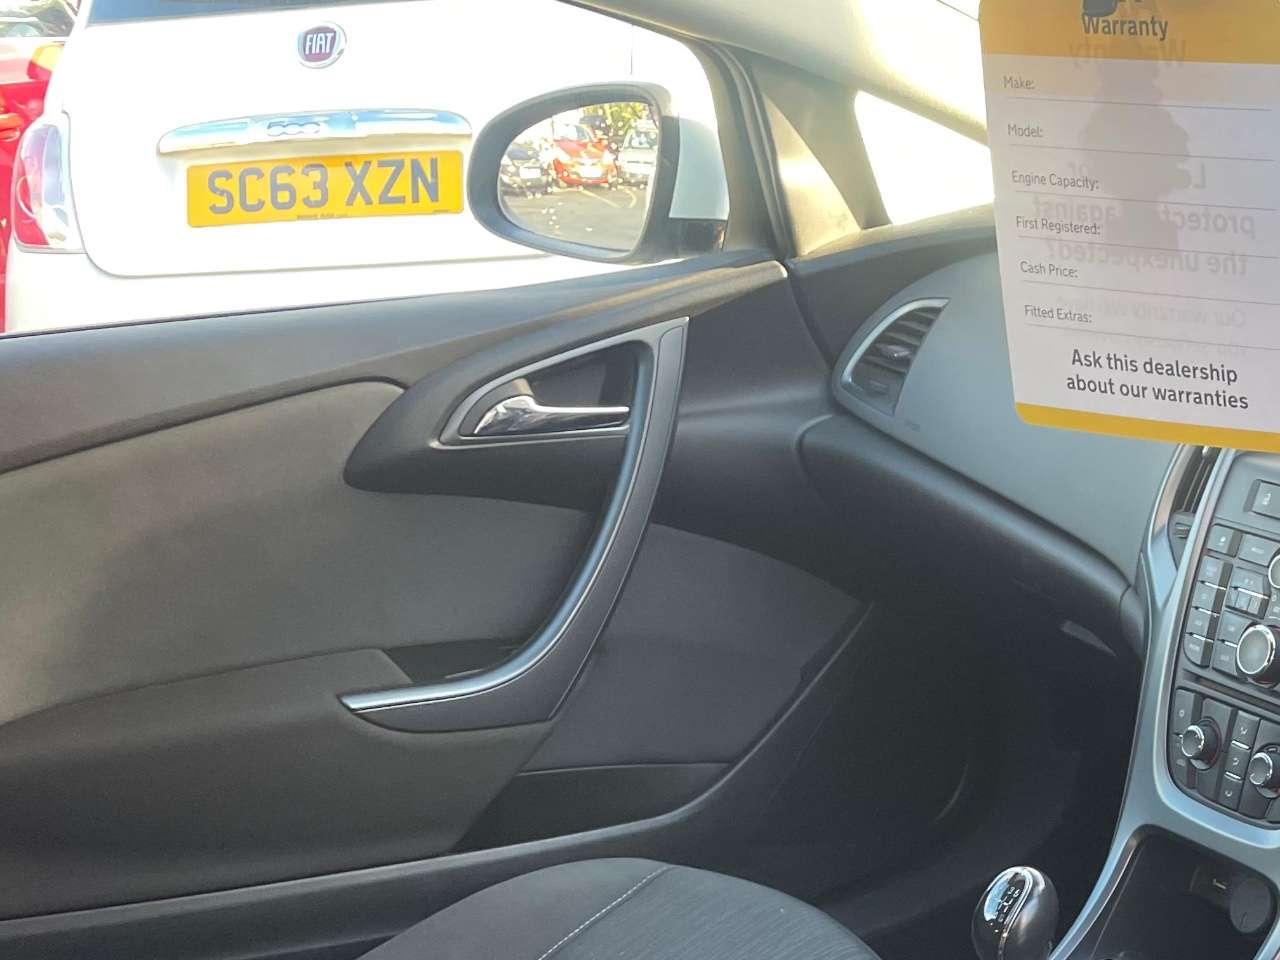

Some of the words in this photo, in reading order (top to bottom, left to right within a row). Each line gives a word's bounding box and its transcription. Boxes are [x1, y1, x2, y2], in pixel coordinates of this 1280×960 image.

[1081, 15, 1168, 42] Warranty
[304, 31, 335, 56] FIAT
[1003, 76, 1035, 91] Make:
[1007, 123, 1043, 138] Model:
[208, 162, 328, 215] SC63
[344, 157, 439, 207] XZN
[1012, 171, 1047, 187] Engine
[1049, 174, 1100, 191] Capacity:
[1016, 215, 1039, 230] First
[1041, 219, 1101, 236] Registered:
[1020, 261, 1047, 276] Cash
[1049, 264, 1079, 279] Price:
[1024, 304, 1055, 320] Fitted
[1057, 308, 1093, 324] Extras:
[1071, 348, 1103, 368] Ask
[1106, 353, 1138, 373] this
[1143, 357, 1239, 385] dealership
[1066, 375, 1116, 396] about
[1119, 383, 1149, 400] our
[1152, 386, 1249, 410] warranties
